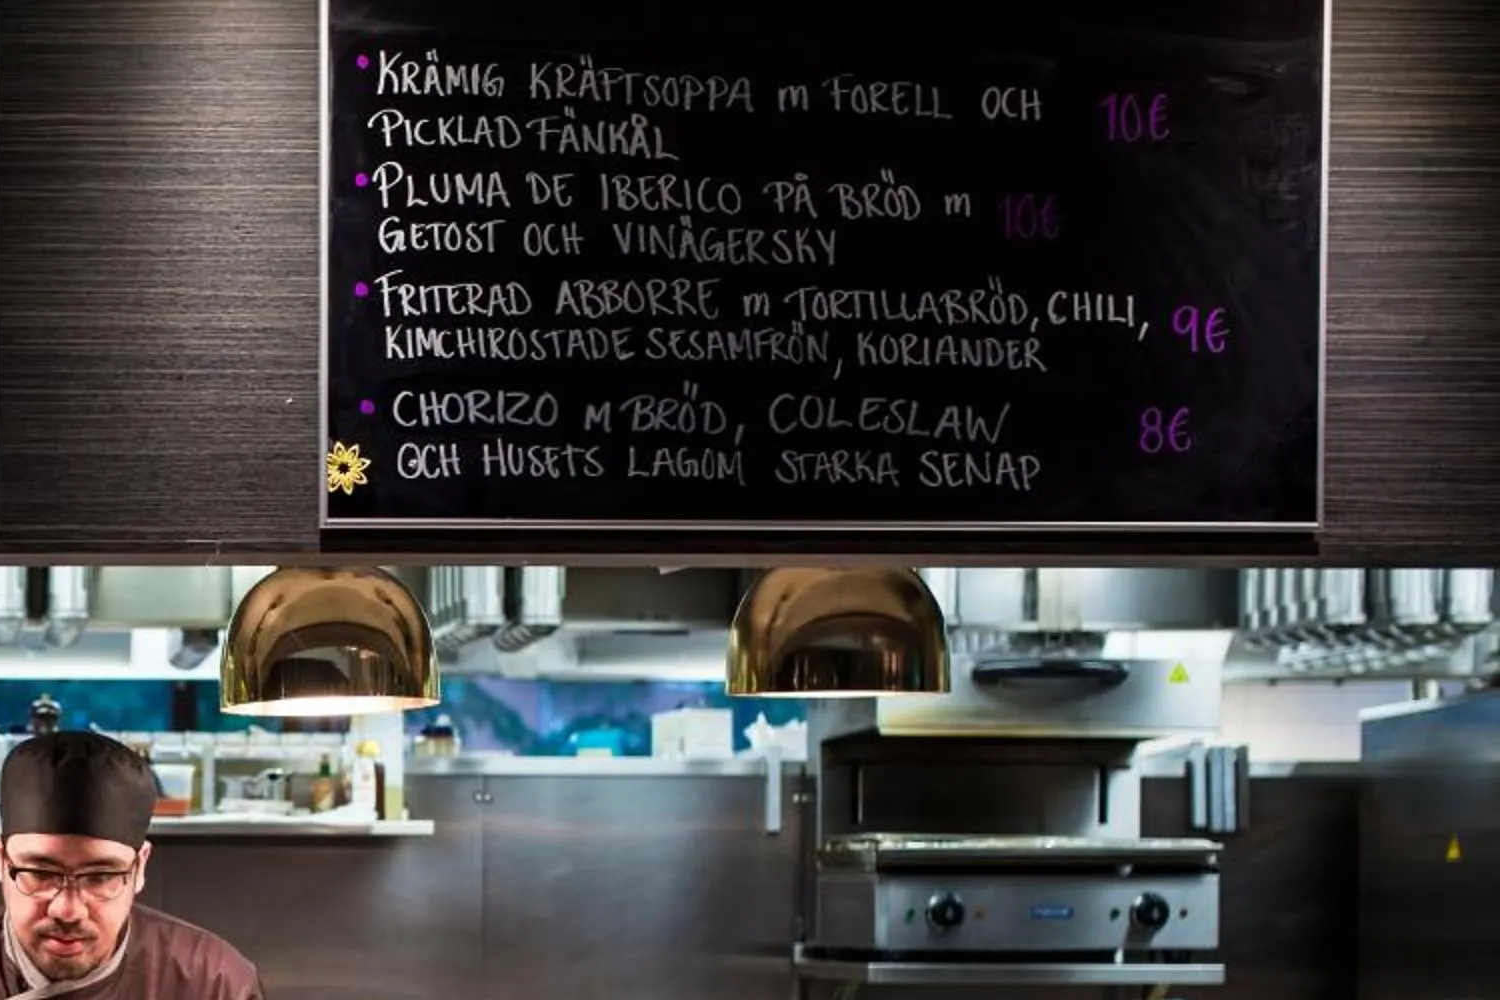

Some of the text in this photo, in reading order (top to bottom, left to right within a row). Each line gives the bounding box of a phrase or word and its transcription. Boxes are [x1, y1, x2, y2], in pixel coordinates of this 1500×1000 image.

[376, 48, 505, 98] KRÄMIG
[529, 53, 754, 112] KRÄFTSOPPA
[826, 74, 953, 119] FORELL
[981, 86, 1042, 121] OCH
[368, 105, 679, 161] PICKLAD FÄNKÅL
[372, 161, 511, 208] PLUMA
[525, 172, 575, 206] DE
[600, 173, 741, 214] IBERICO
[763, 172, 818, 218] PÅ
[827, 168, 921, 221] BRÖD
[378, 216, 836, 265] GETOST OCH VINÄGERSKY
[373, 270, 532, 318] FRITERAD
[556, 278, 722, 319] ABBORRE
[1172, 305, 1231, 354] 9€
[385, 327, 635, 360] KIMCHIROSTADE
[857, 333, 1048, 372] KORIANDER
[392, 390, 558, 428] CHORIZO
[768, 393, 1011, 444] COLESLAW
[1139, 407, 1192, 453] 8€
[483, 438, 604, 478] HUSETS
[627, 444, 746, 486] LAGOM
[774, 449, 899, 487] STARKA
[919, 451, 1041, 491] SENAP
